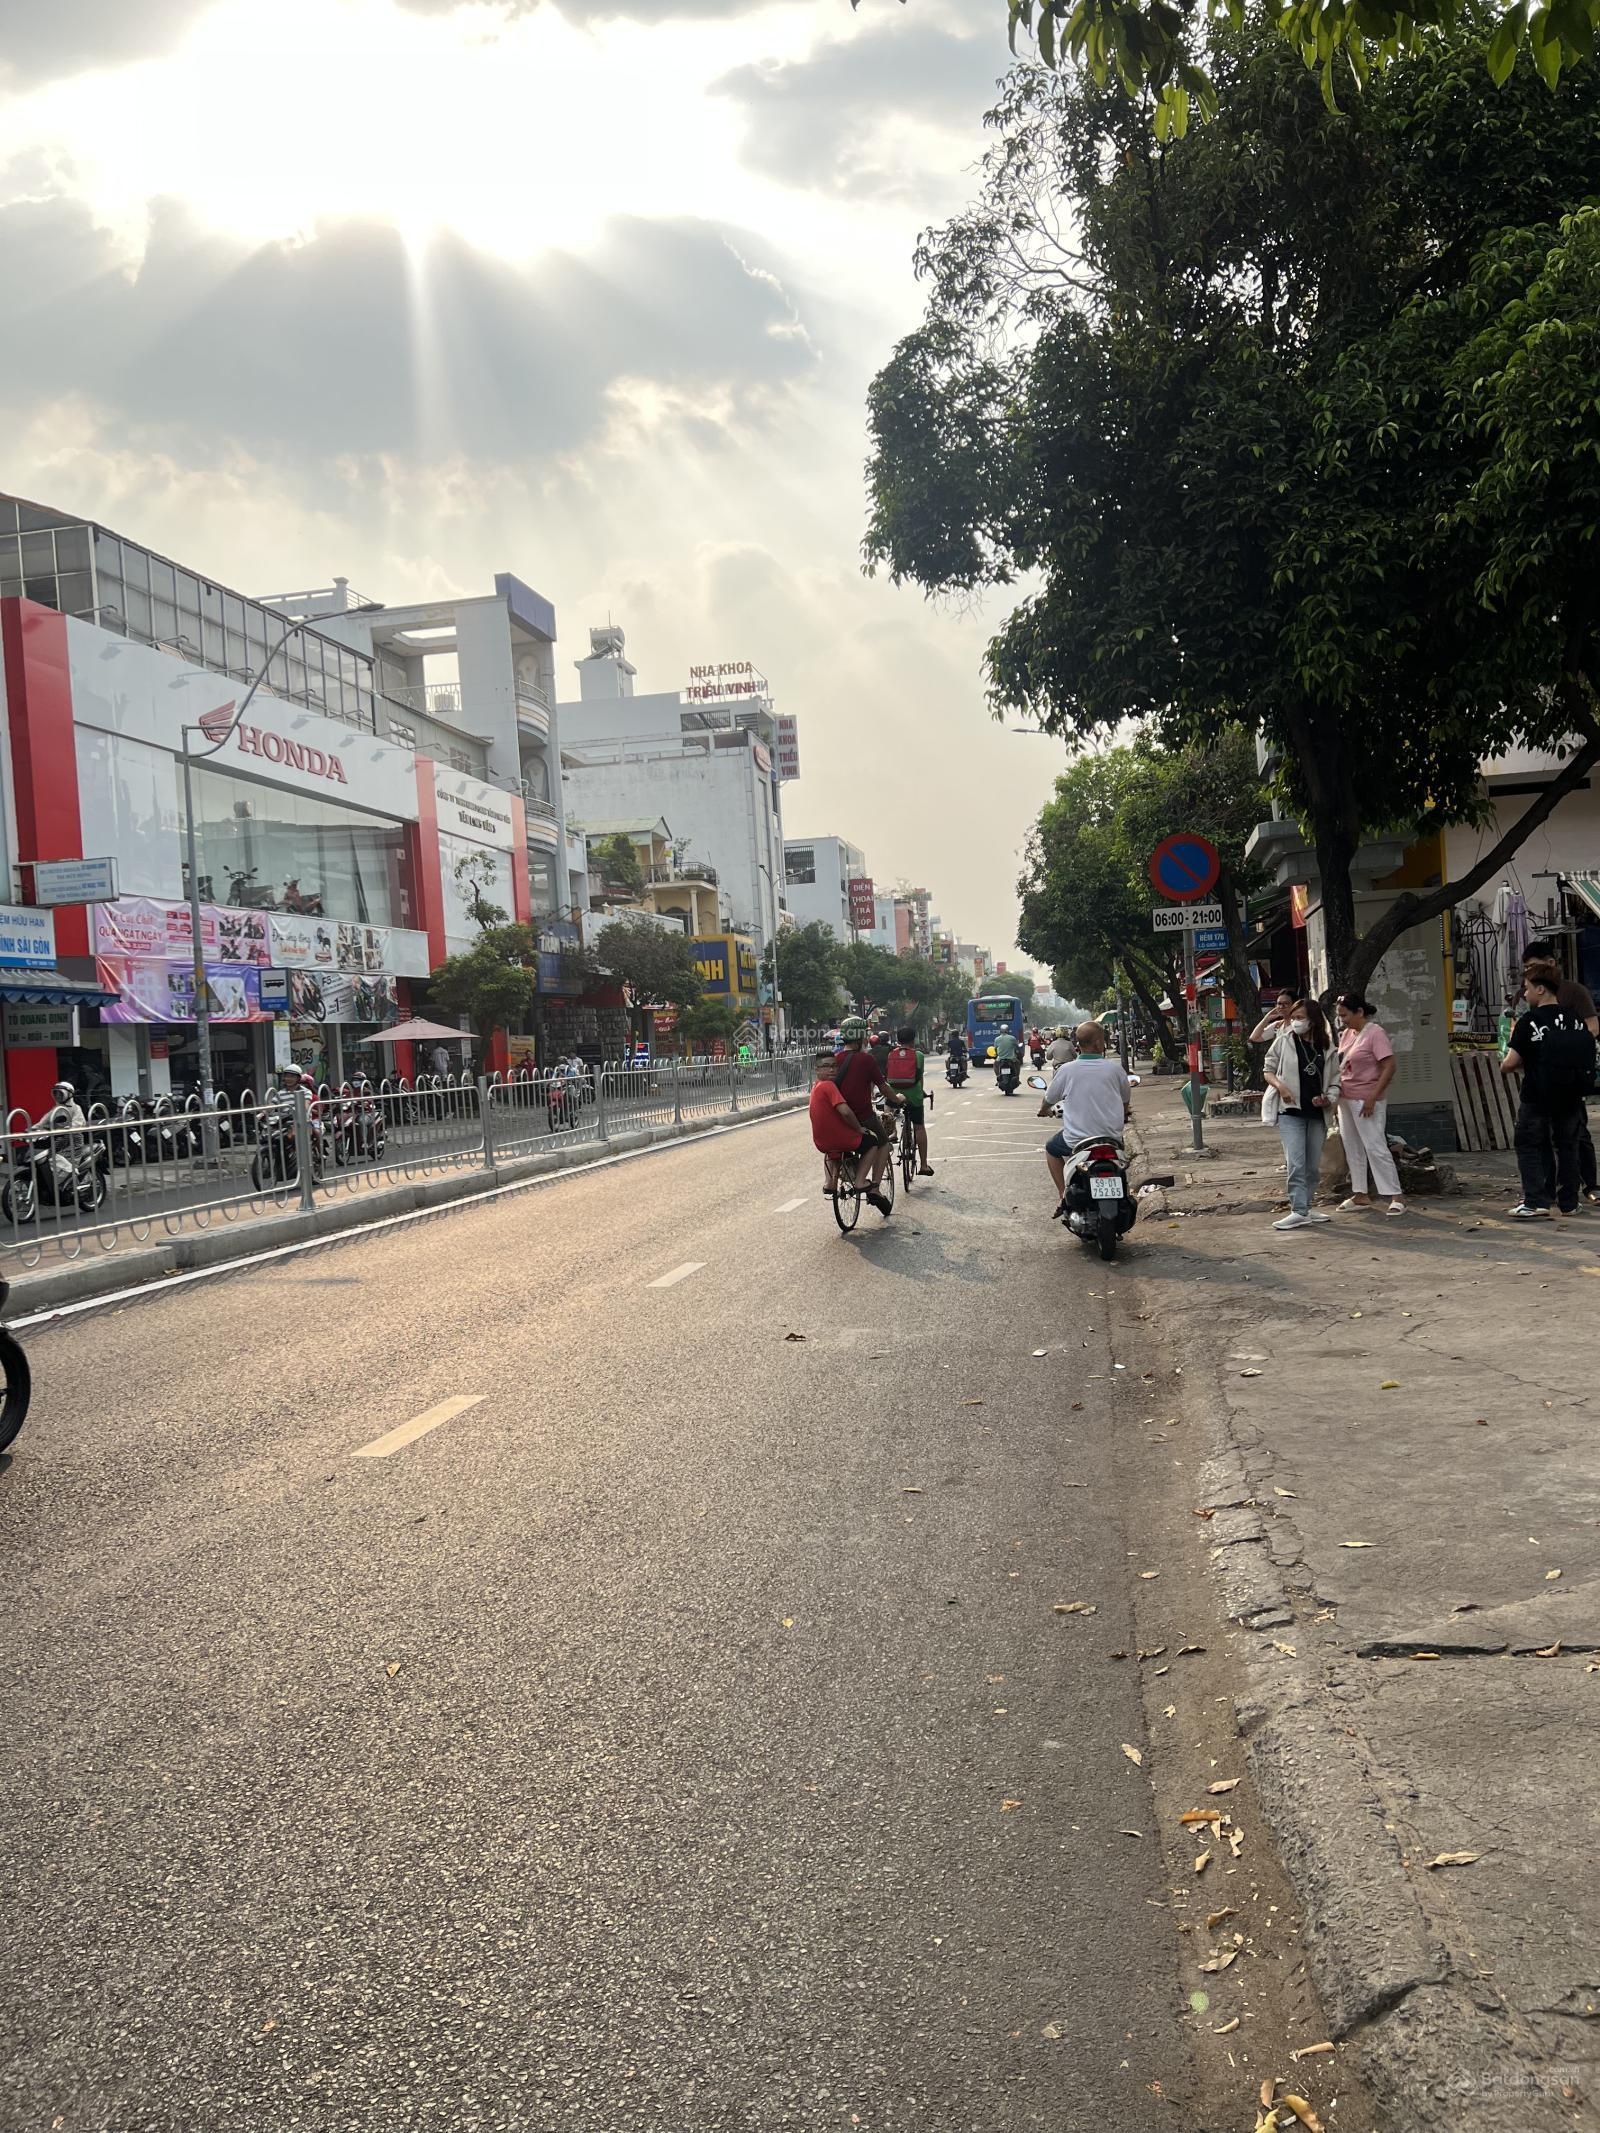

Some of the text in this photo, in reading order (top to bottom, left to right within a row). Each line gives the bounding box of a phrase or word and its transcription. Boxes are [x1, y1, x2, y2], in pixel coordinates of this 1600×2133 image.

[690, 661, 753, 678] NHA KHOA
[728, 681, 756, 695] VINH
[778, 735, 796, 745] KHOA
[237, 721, 348, 785] HONDA
[1155, 912, 1184, 927] 06:00
[1192, 909, 1221, 924] 21:00
